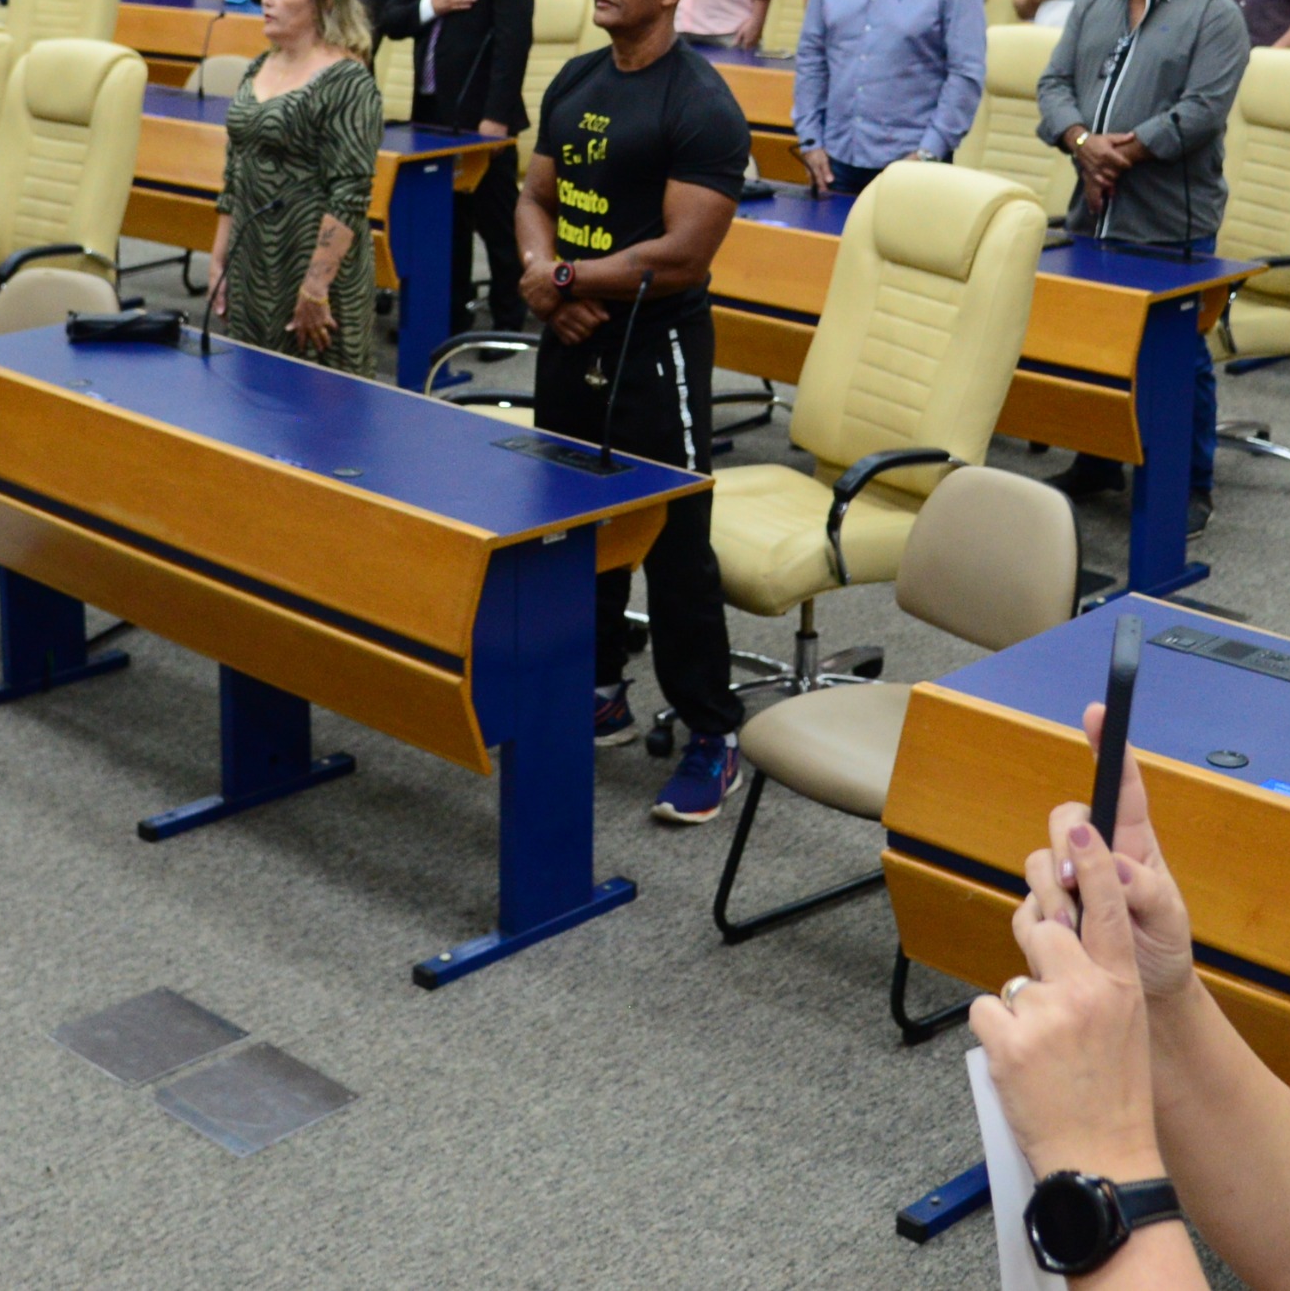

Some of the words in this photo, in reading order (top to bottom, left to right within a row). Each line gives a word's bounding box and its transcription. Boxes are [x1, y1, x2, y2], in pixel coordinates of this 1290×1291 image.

[578, 112, 610, 133] 2022
[563, 144, 582, 165] Eu
[590, 226, 612, 251] do
